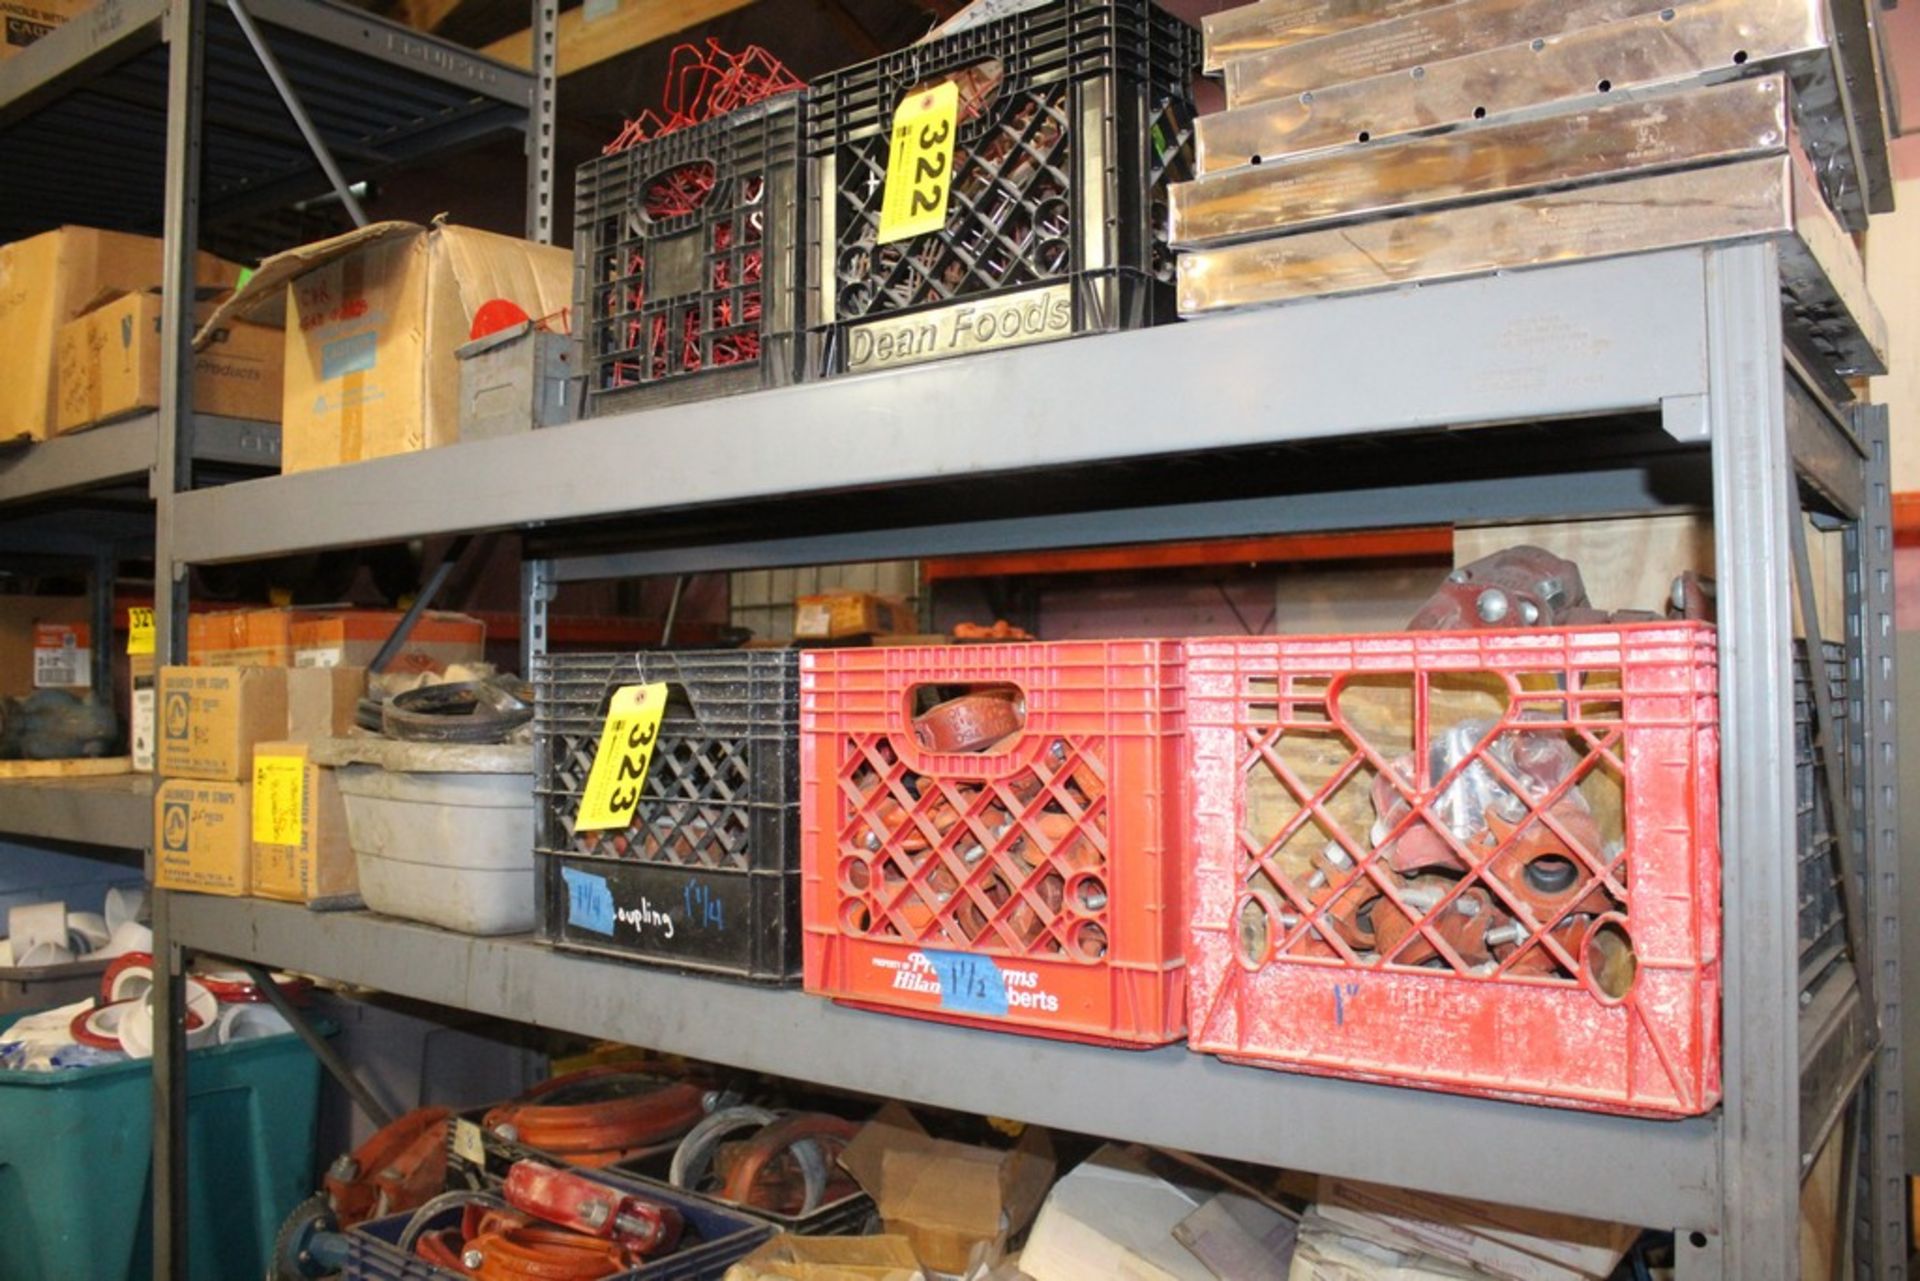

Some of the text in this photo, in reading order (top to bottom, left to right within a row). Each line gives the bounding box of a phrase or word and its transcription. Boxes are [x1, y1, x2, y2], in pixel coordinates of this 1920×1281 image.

[911, 119, 949, 216] 322
[851, 293, 1070, 366] Dean Foods
[195, 359, 262, 380] Products
[609, 721, 655, 813] 323
[613, 896, 675, 939] oupling
[892, 969, 1059, 1013] Hilan berts
[999, 967, 1039, 988] rms
